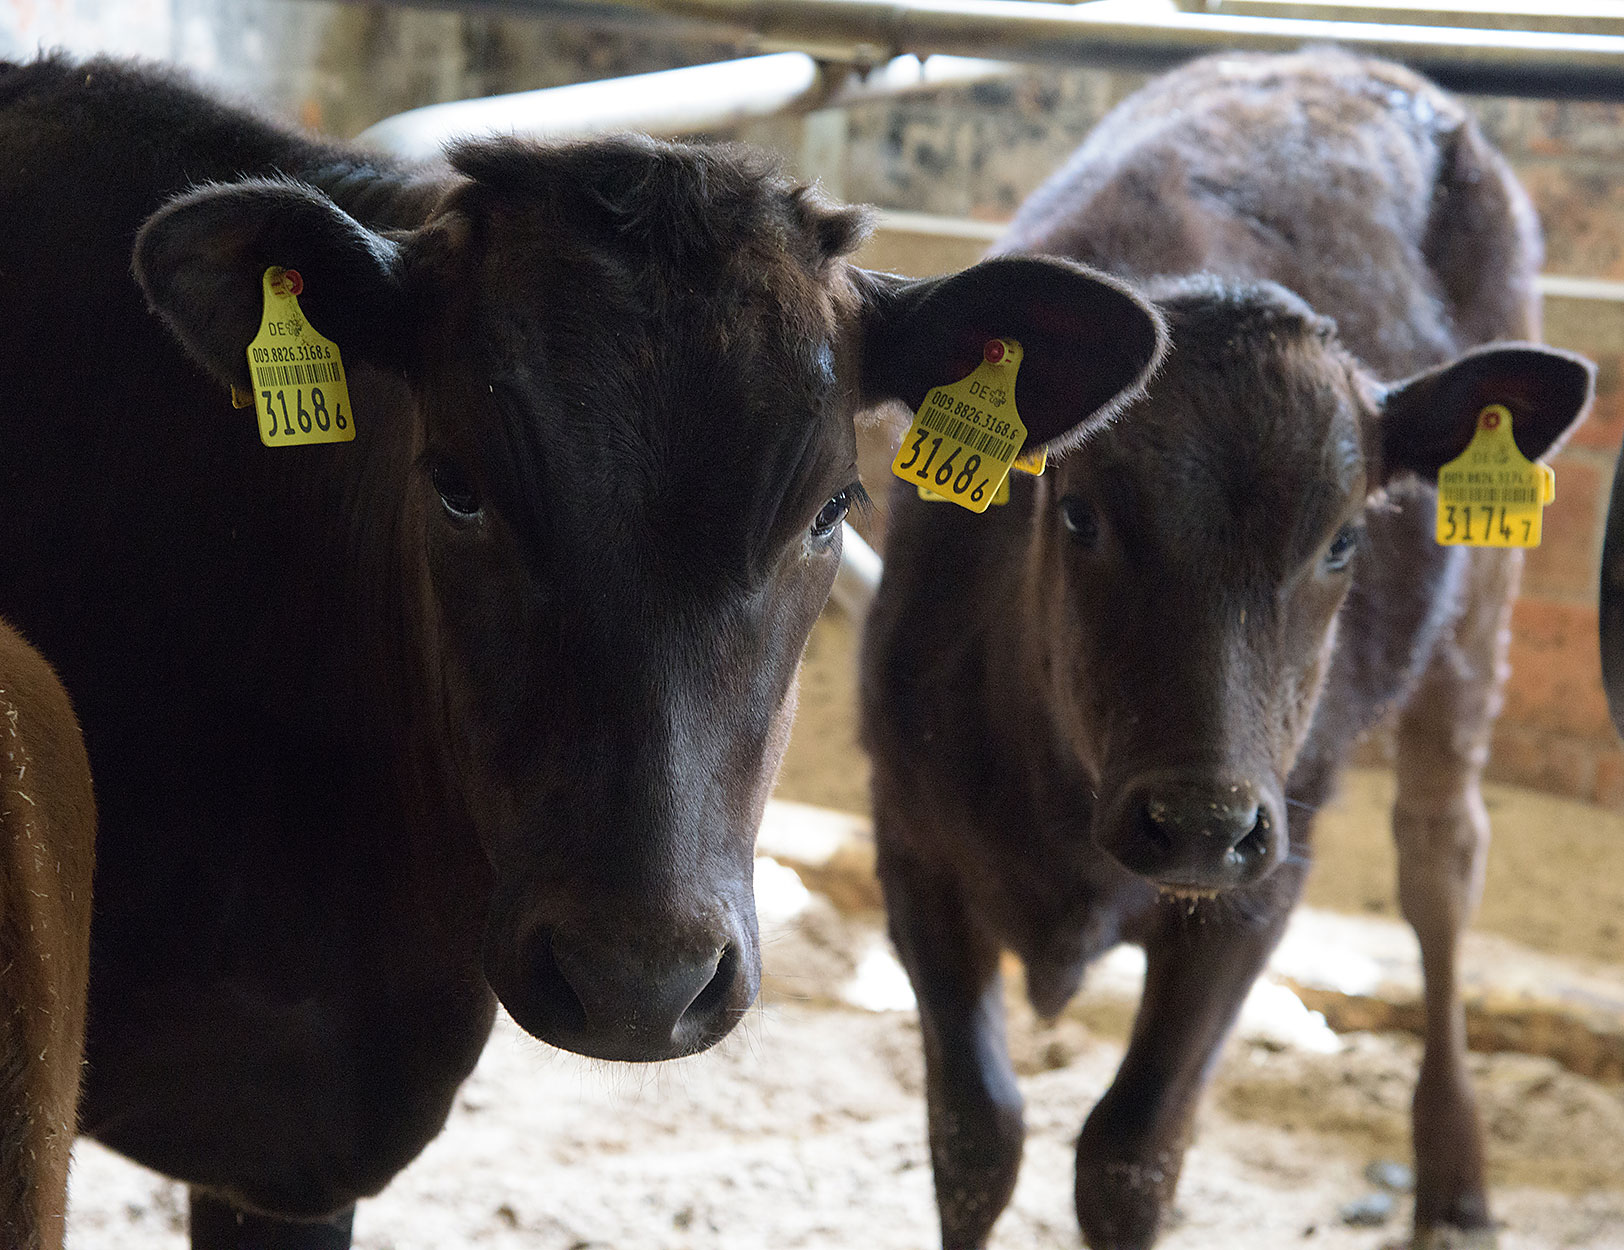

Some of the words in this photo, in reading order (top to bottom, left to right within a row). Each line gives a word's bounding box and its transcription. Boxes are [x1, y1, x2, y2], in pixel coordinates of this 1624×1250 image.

[268, 322, 286, 336] DE
[253, 345, 331, 363] 009.8826.3168.6
[969, 381, 990, 400] DE
[932, 391, 1019, 440] 009.8826.3168.6
